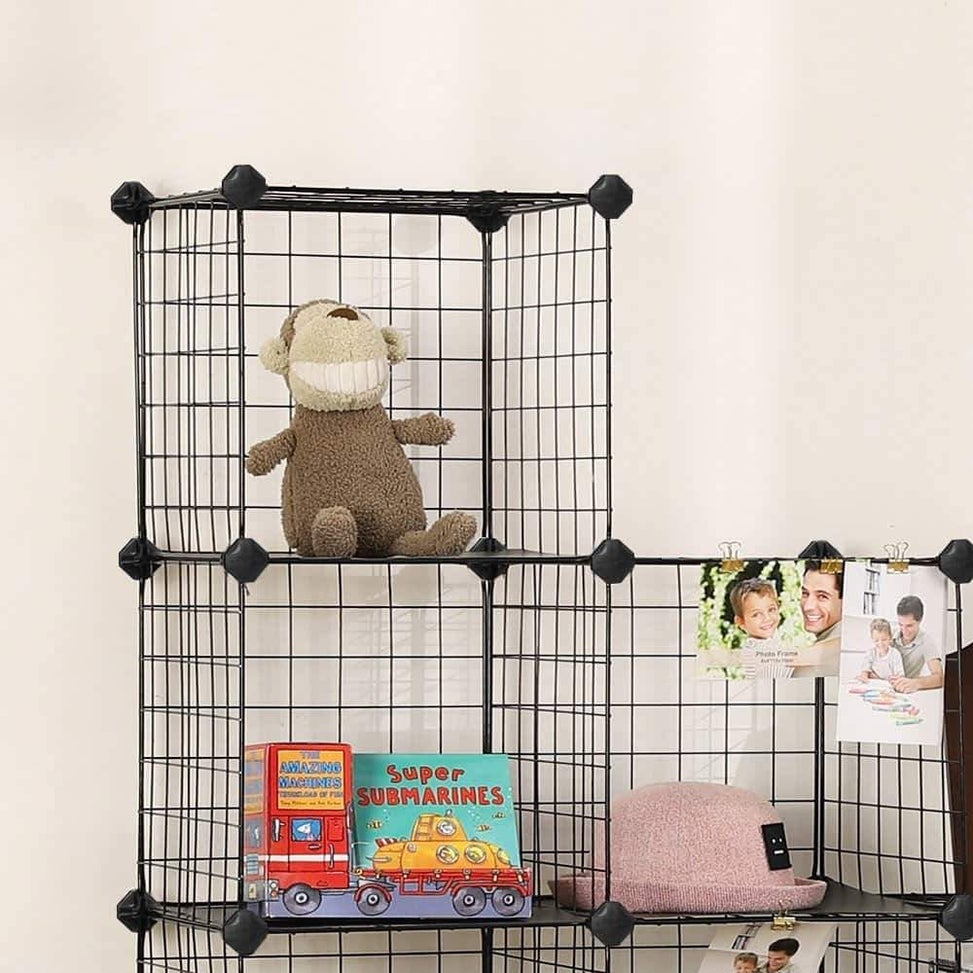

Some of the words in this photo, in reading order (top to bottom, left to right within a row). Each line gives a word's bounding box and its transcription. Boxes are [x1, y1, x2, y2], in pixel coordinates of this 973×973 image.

[279, 760, 343, 775] AMAZING
[386, 764, 465, 785] Super
[278, 776, 343, 789] MACHINES
[356, 786, 505, 806] SUBMARINES
